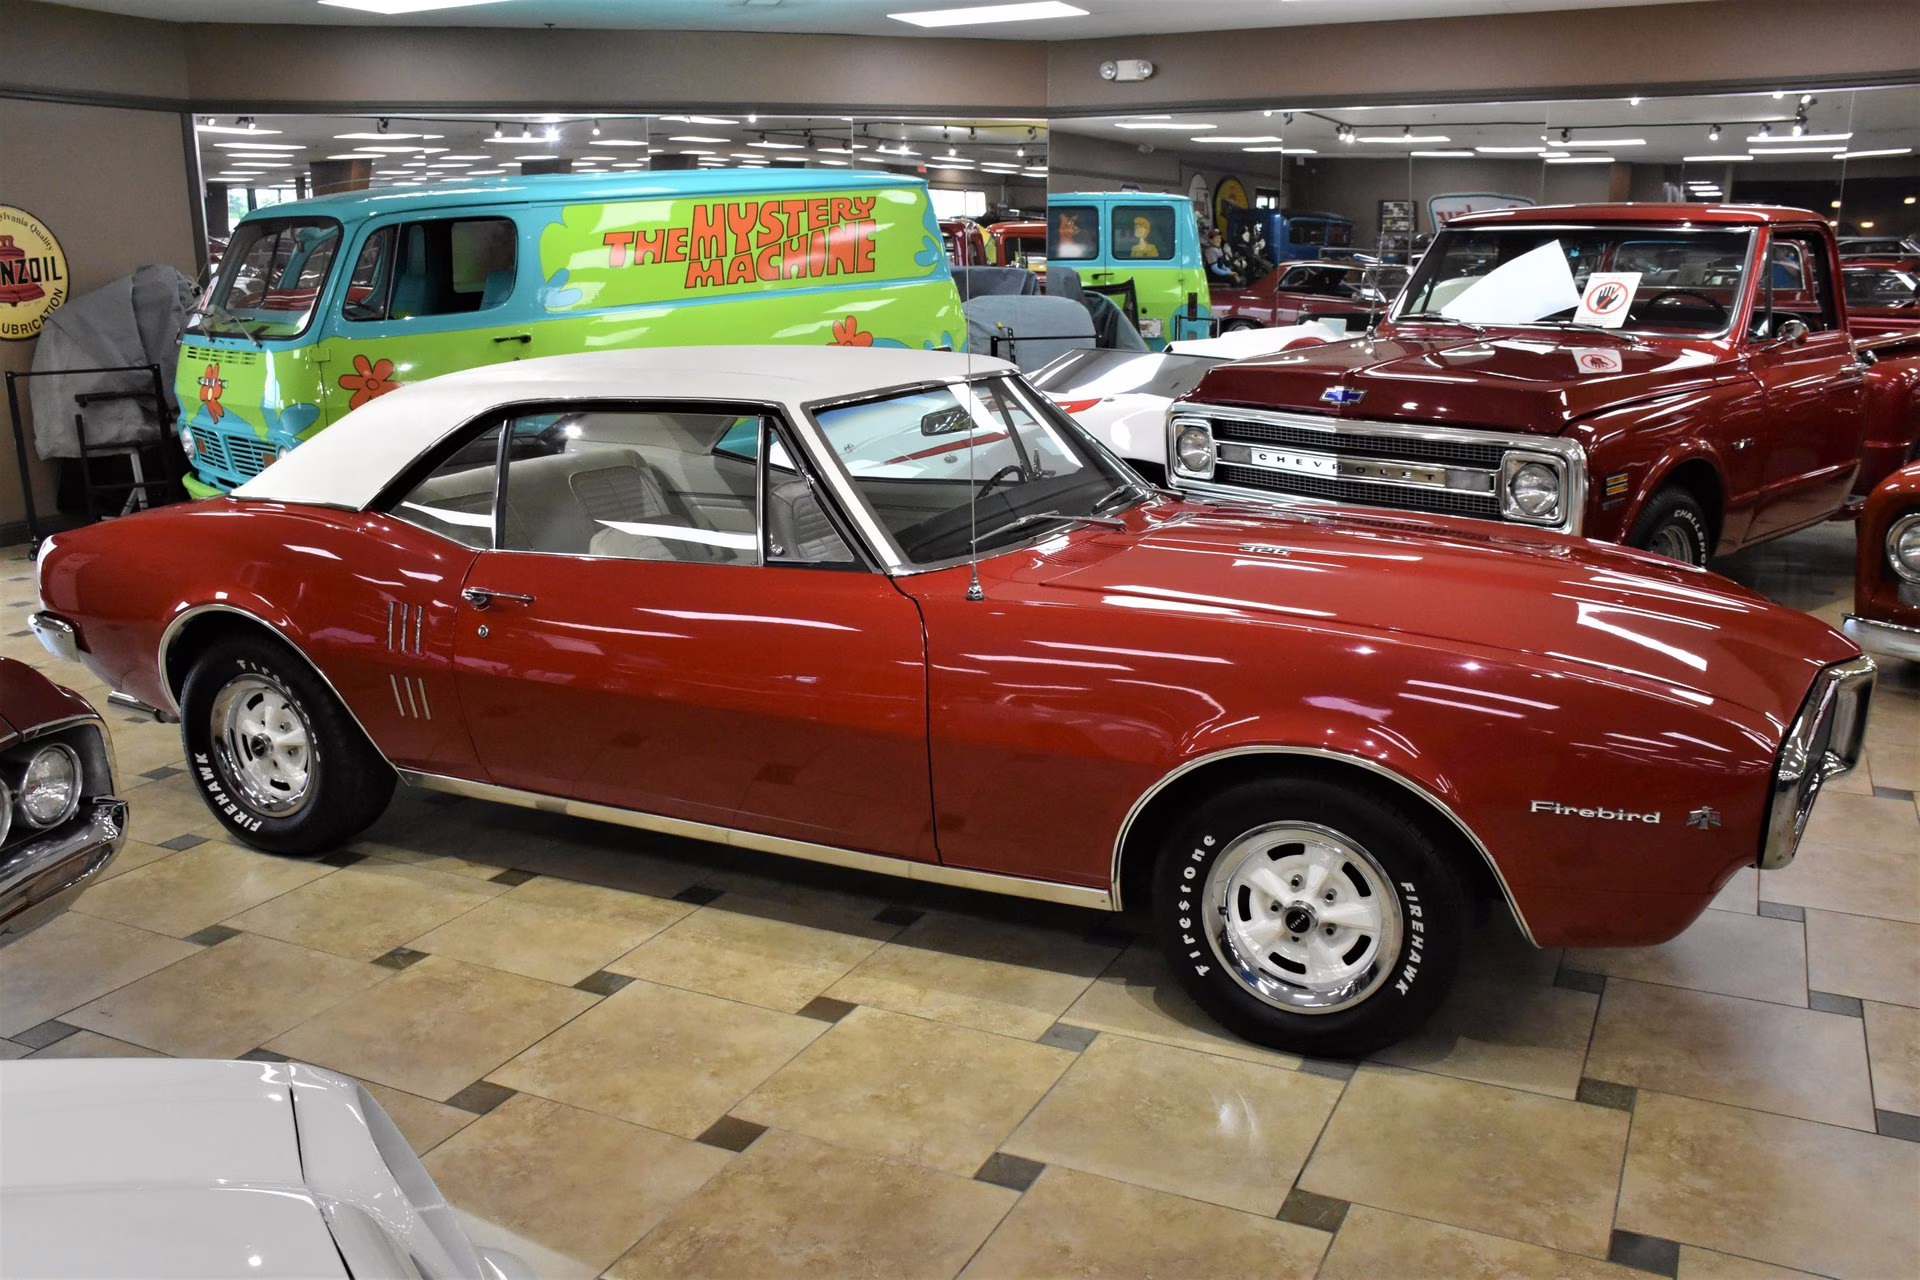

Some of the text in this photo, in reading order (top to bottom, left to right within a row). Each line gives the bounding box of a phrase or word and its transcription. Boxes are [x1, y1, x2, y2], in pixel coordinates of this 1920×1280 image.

[30, 223, 54, 251] Quality
[603, 196, 876, 268] THE MYSTERY
[684, 219, 877, 289] MACHINE
[2, 288, 64, 335] UBRICATION
[1259, 453, 1435, 481] CHEVROLET
[1674, 509, 1706, 568] CHALLENG
[194, 753, 263, 832] FIREHAWK
[1530, 800, 1661, 824] Firebird
[1179, 834, 1216, 978] Firestone
[1395, 881, 1425, 996] FIREHAWK
